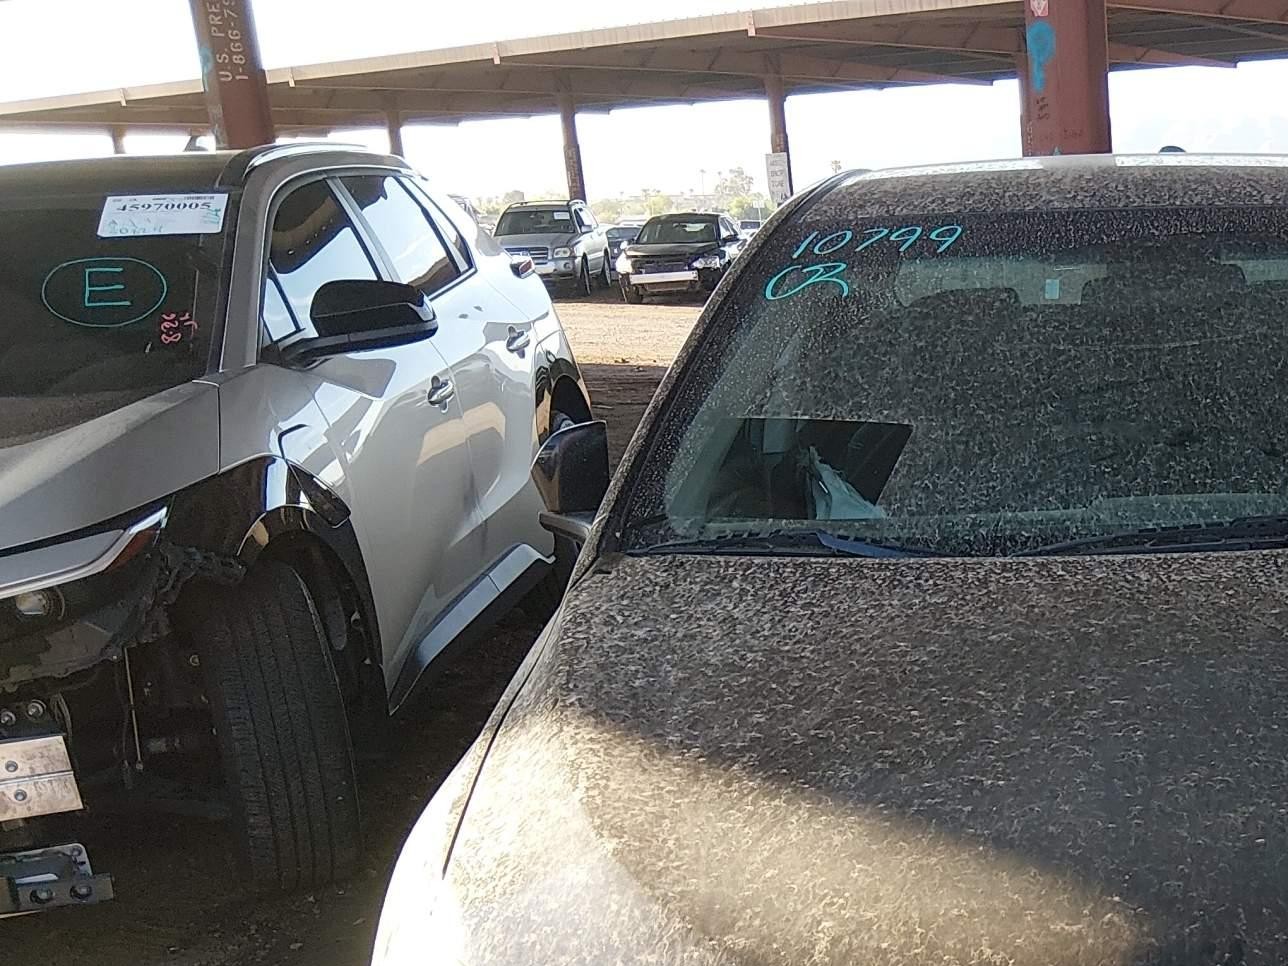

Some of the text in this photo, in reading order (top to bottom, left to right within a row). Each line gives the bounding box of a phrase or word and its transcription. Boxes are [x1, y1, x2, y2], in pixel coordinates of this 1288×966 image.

[216, 48, 233, 82] U.S.
[116, 202, 212, 212] 45970005
[792, 226, 962, 259] 10799
[84, 268, 131, 306] E
